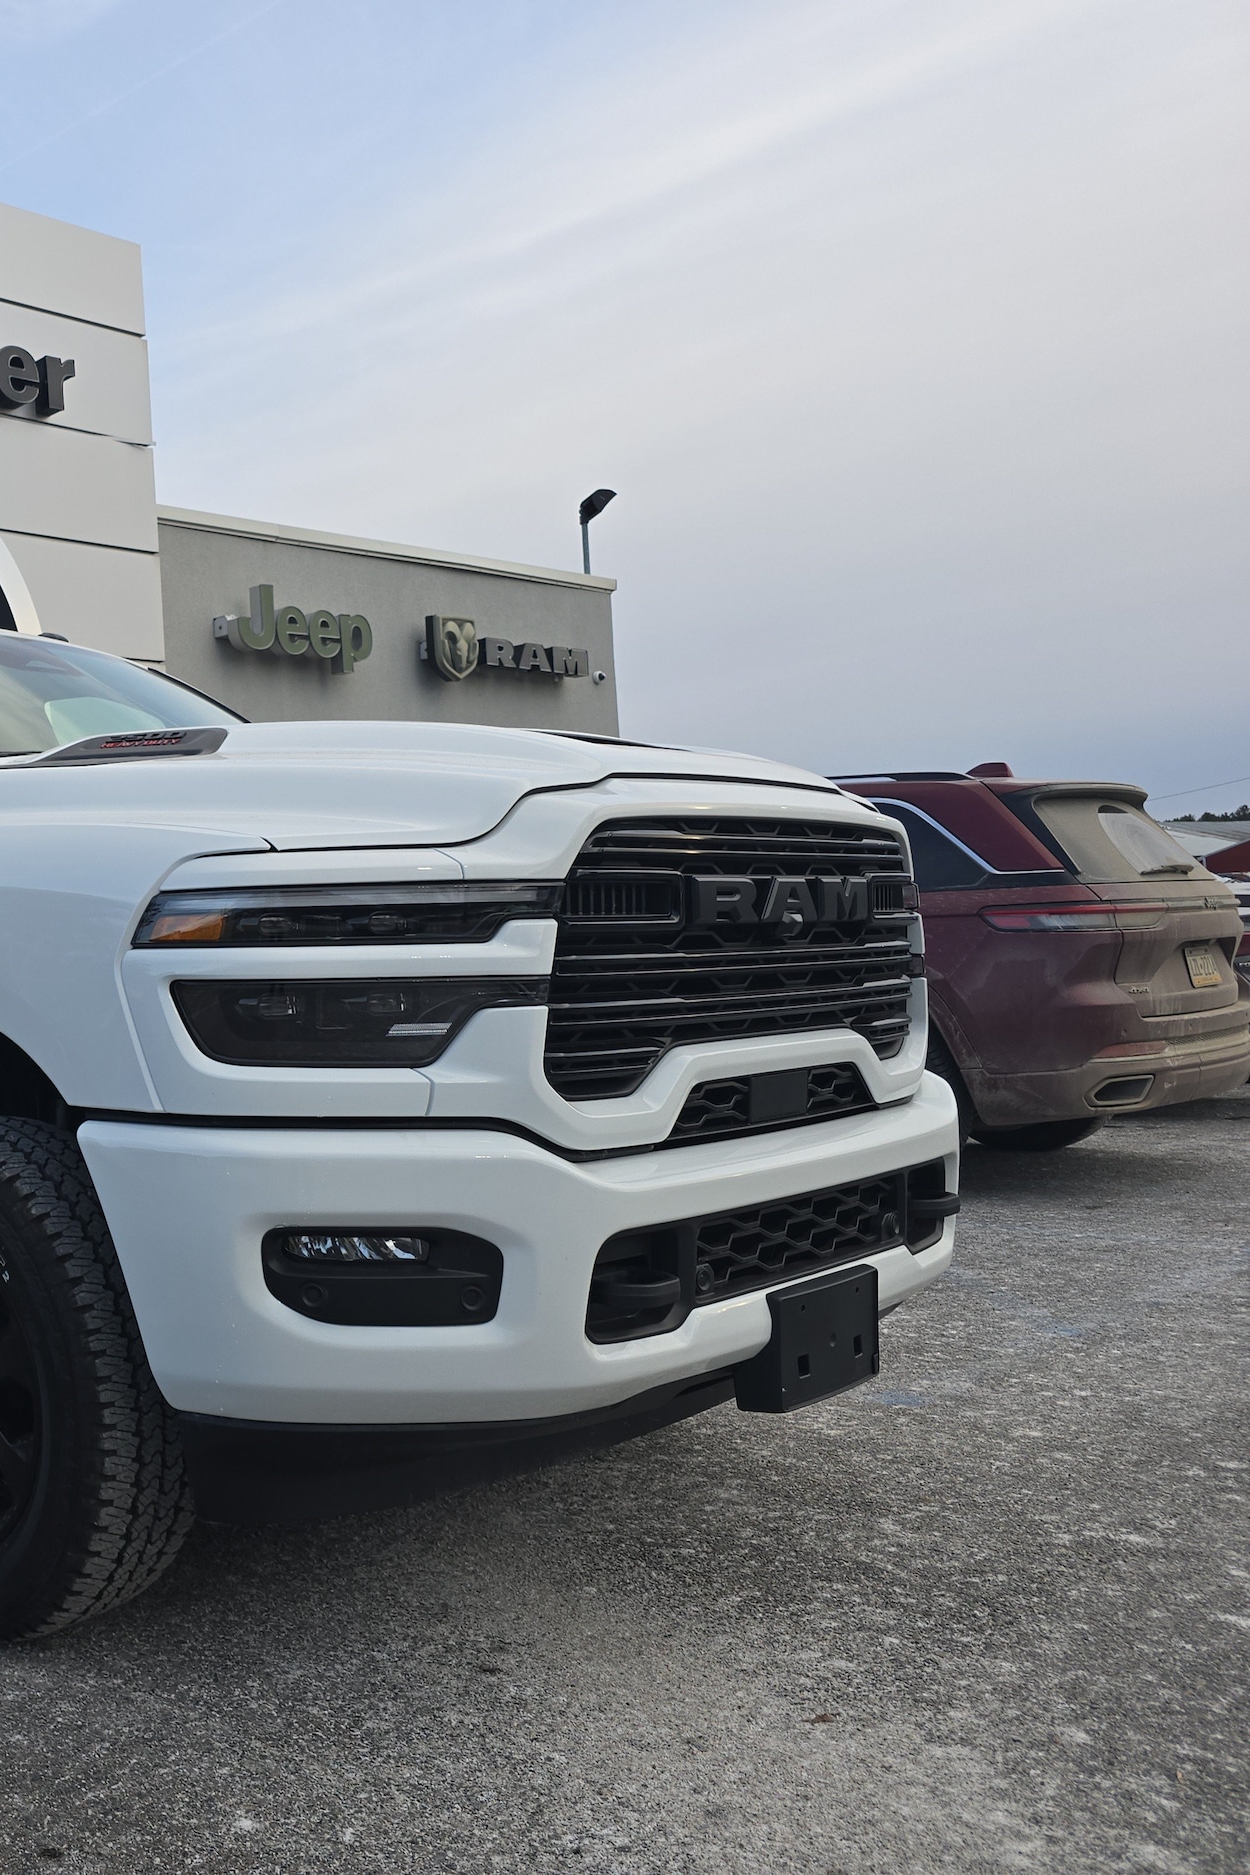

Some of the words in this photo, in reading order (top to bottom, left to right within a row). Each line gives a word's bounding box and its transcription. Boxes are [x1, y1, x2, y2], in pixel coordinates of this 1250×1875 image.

[228, 583, 373, 675] Jeep
[480, 636, 590, 678] RAM
[692, 874, 869, 925] RAM
